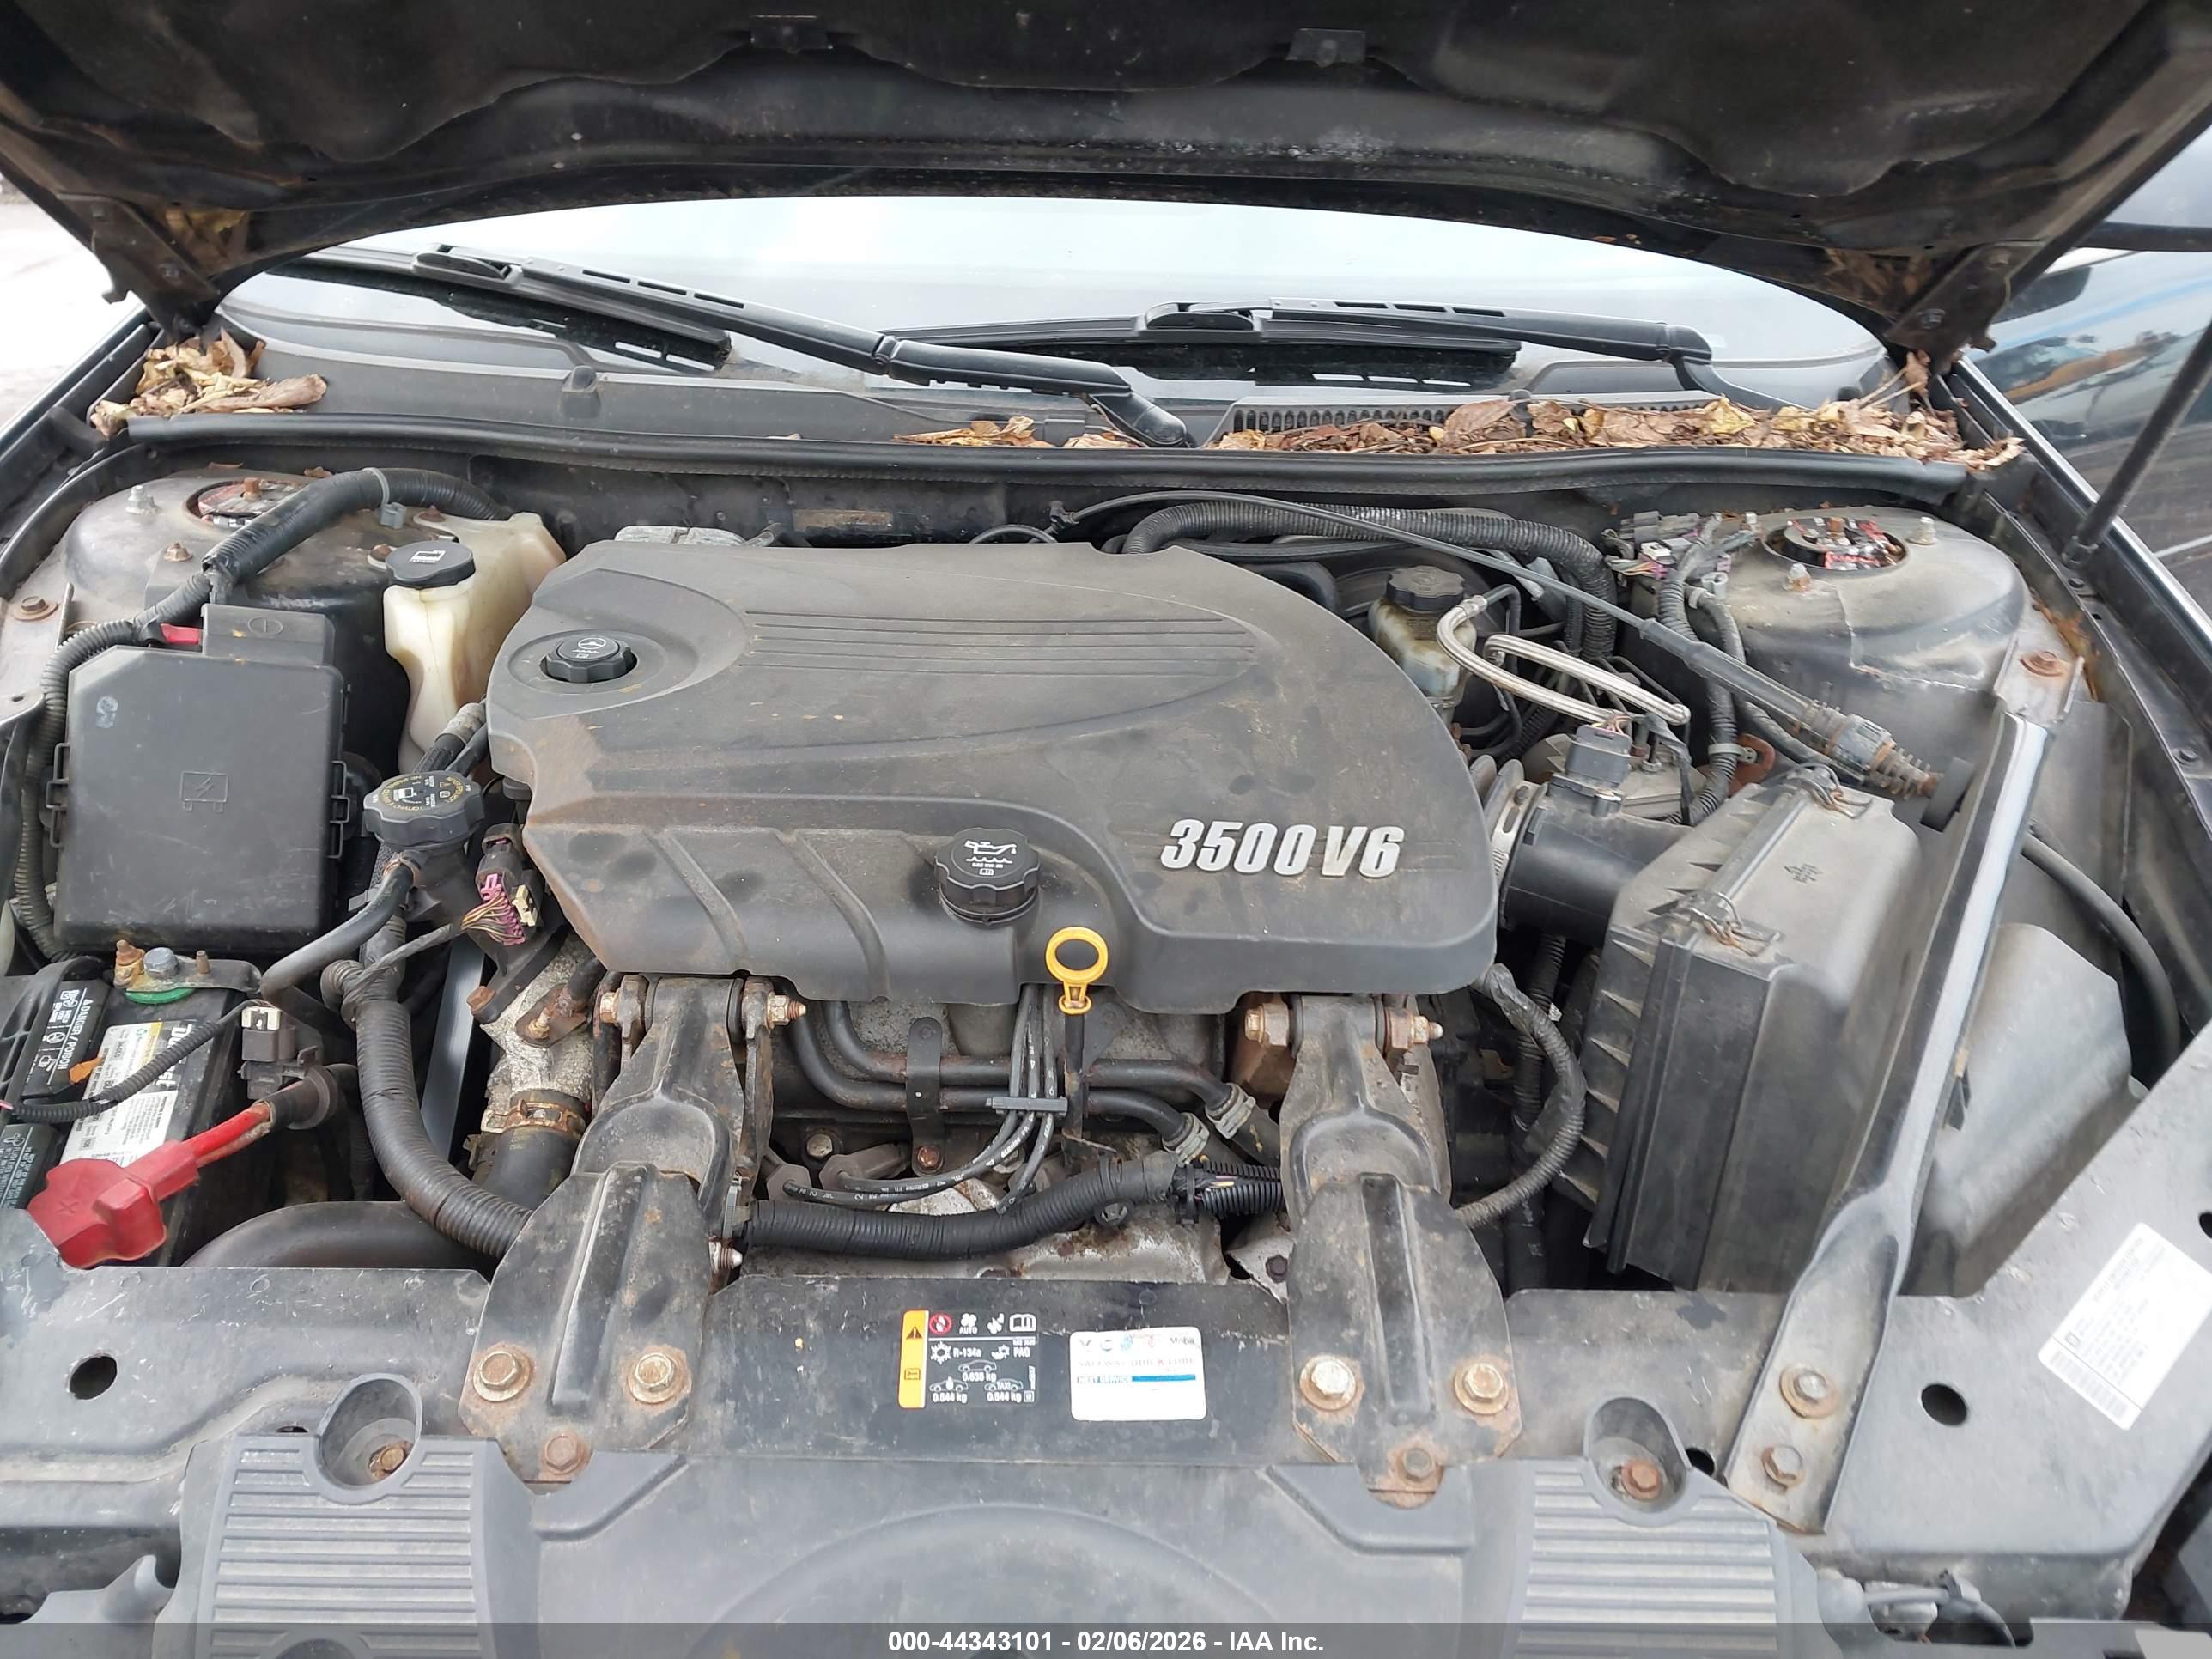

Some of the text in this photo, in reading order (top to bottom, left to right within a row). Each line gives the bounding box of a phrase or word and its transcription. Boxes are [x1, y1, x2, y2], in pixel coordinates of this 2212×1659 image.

[70, 1006, 90, 1034] DANGER
[57, 1042, 76, 1069] POISON
[953, 1347, 981, 1358] R-134a
[1013, 1347, 1030, 1357] PAG
[986, 1371, 996, 1382] kg
[996, 1382, 1011, 1390] TAXI
[956, 1392, 967, 1403] kg
[1011, 1392, 1022, 1403] kg
